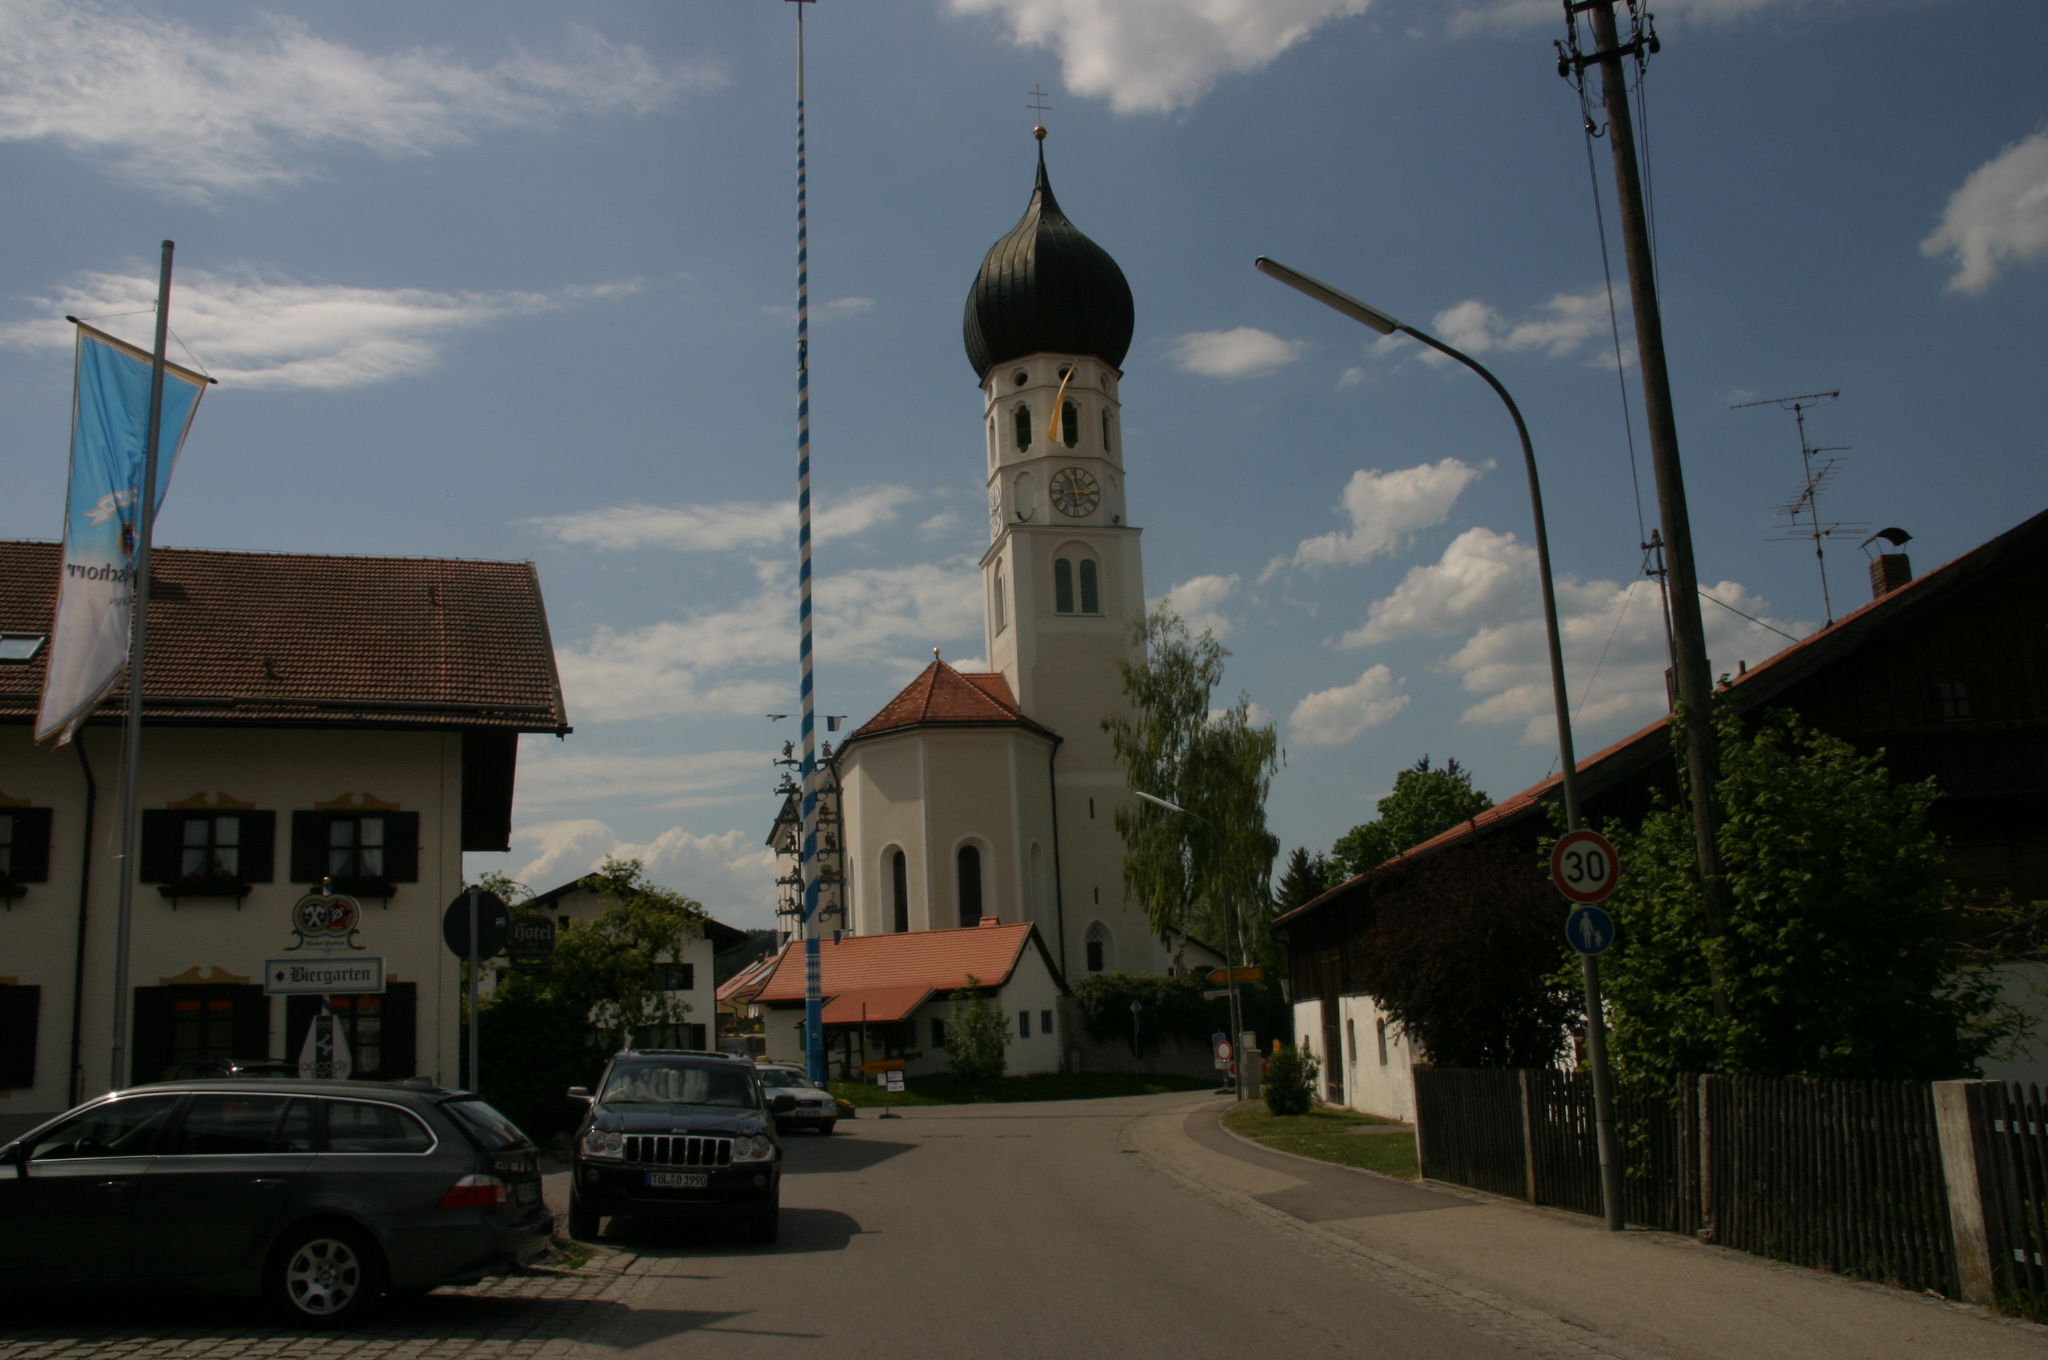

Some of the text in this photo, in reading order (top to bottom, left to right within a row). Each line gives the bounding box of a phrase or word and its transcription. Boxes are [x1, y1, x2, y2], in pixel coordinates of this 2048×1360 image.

[1565, 850, 1604, 883] 30
[514, 922, 551, 943] Hotel
[290, 966, 371, 985] Biergarten
[684, 1175, 706, 1186] 1990
